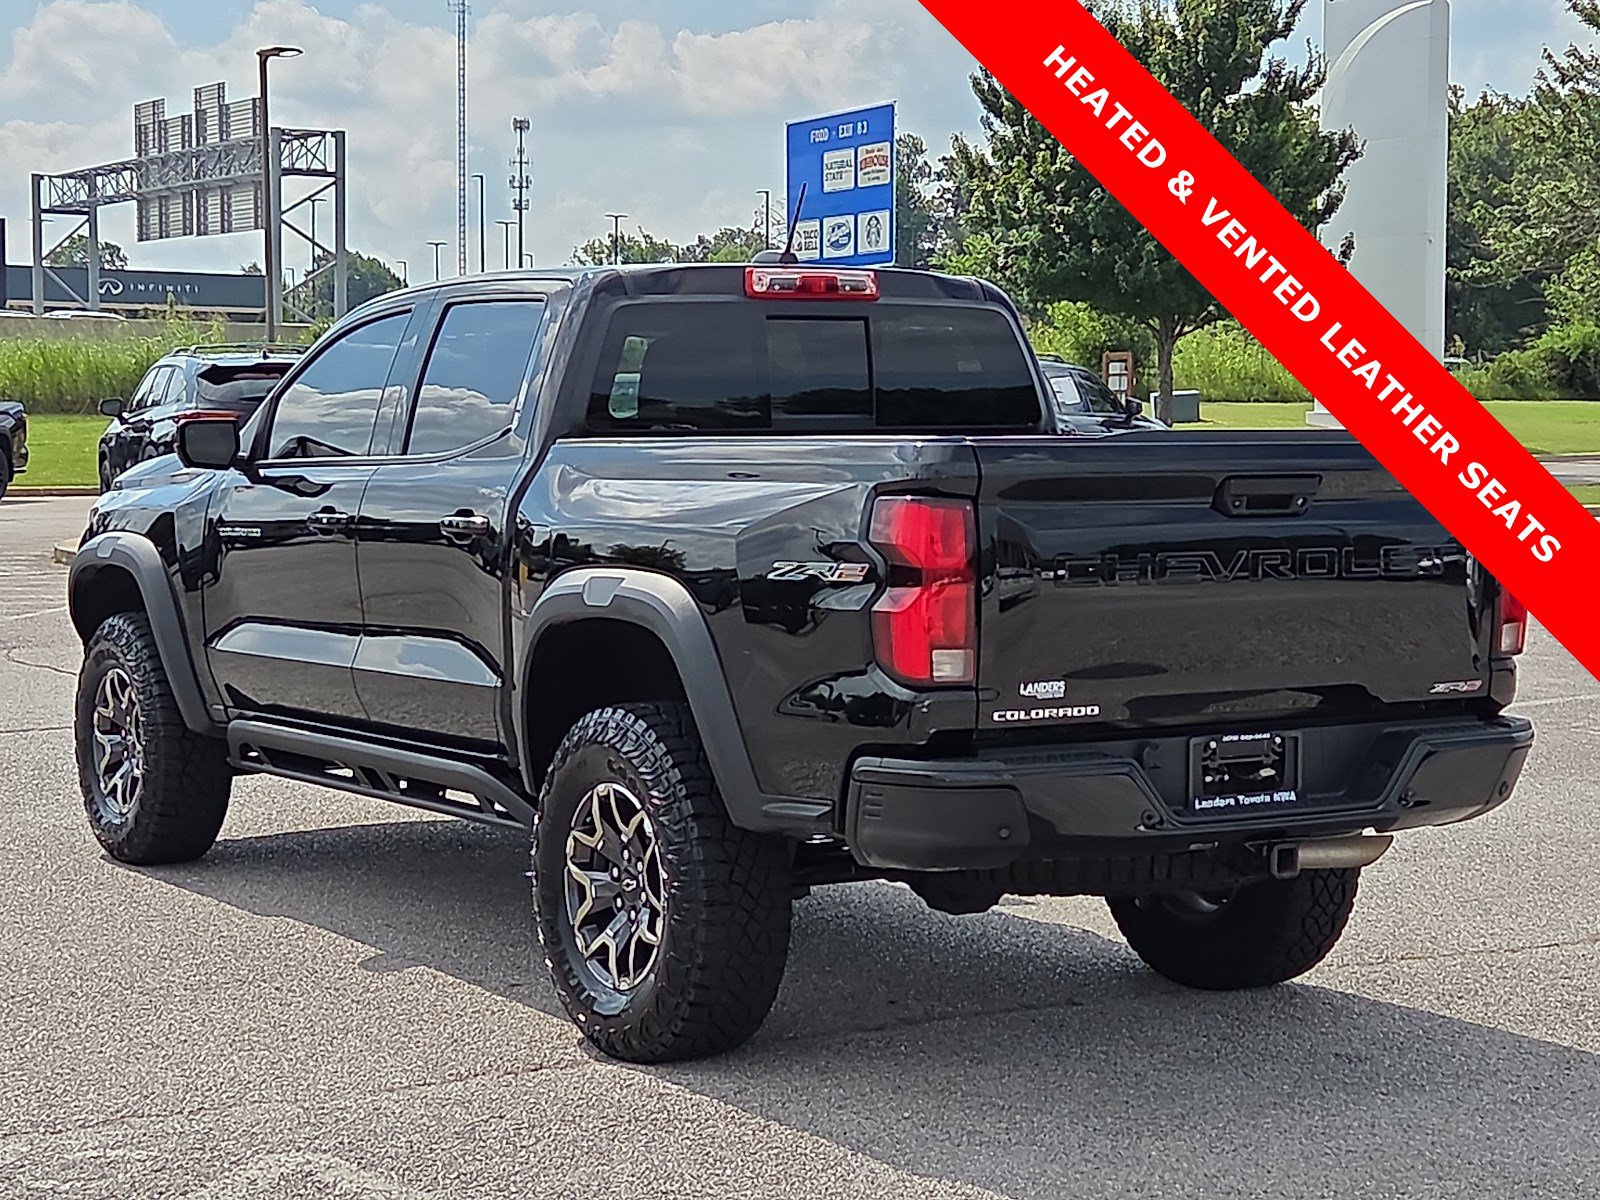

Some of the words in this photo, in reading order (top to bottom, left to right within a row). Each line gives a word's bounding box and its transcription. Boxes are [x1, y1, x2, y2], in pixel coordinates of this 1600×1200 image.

[810, 128, 829, 143] FOOD
[838, 123, 854, 138] EXIT
[825, 159, 853, 170] NATURAL
[825, 170, 843, 182] STATE
[803, 229, 818, 239] TACO
[804, 240, 818, 251] BELL
[130, 283, 199, 293] INFINITI
[1053, 546, 1459, 588] CHEVROLET
[1019, 680, 1066, 696] LANDERS
[992, 705, 1100, 722] COLORADO
[1194, 797, 1236, 810] Landers
[1237, 794, 1271, 805] Toyota
